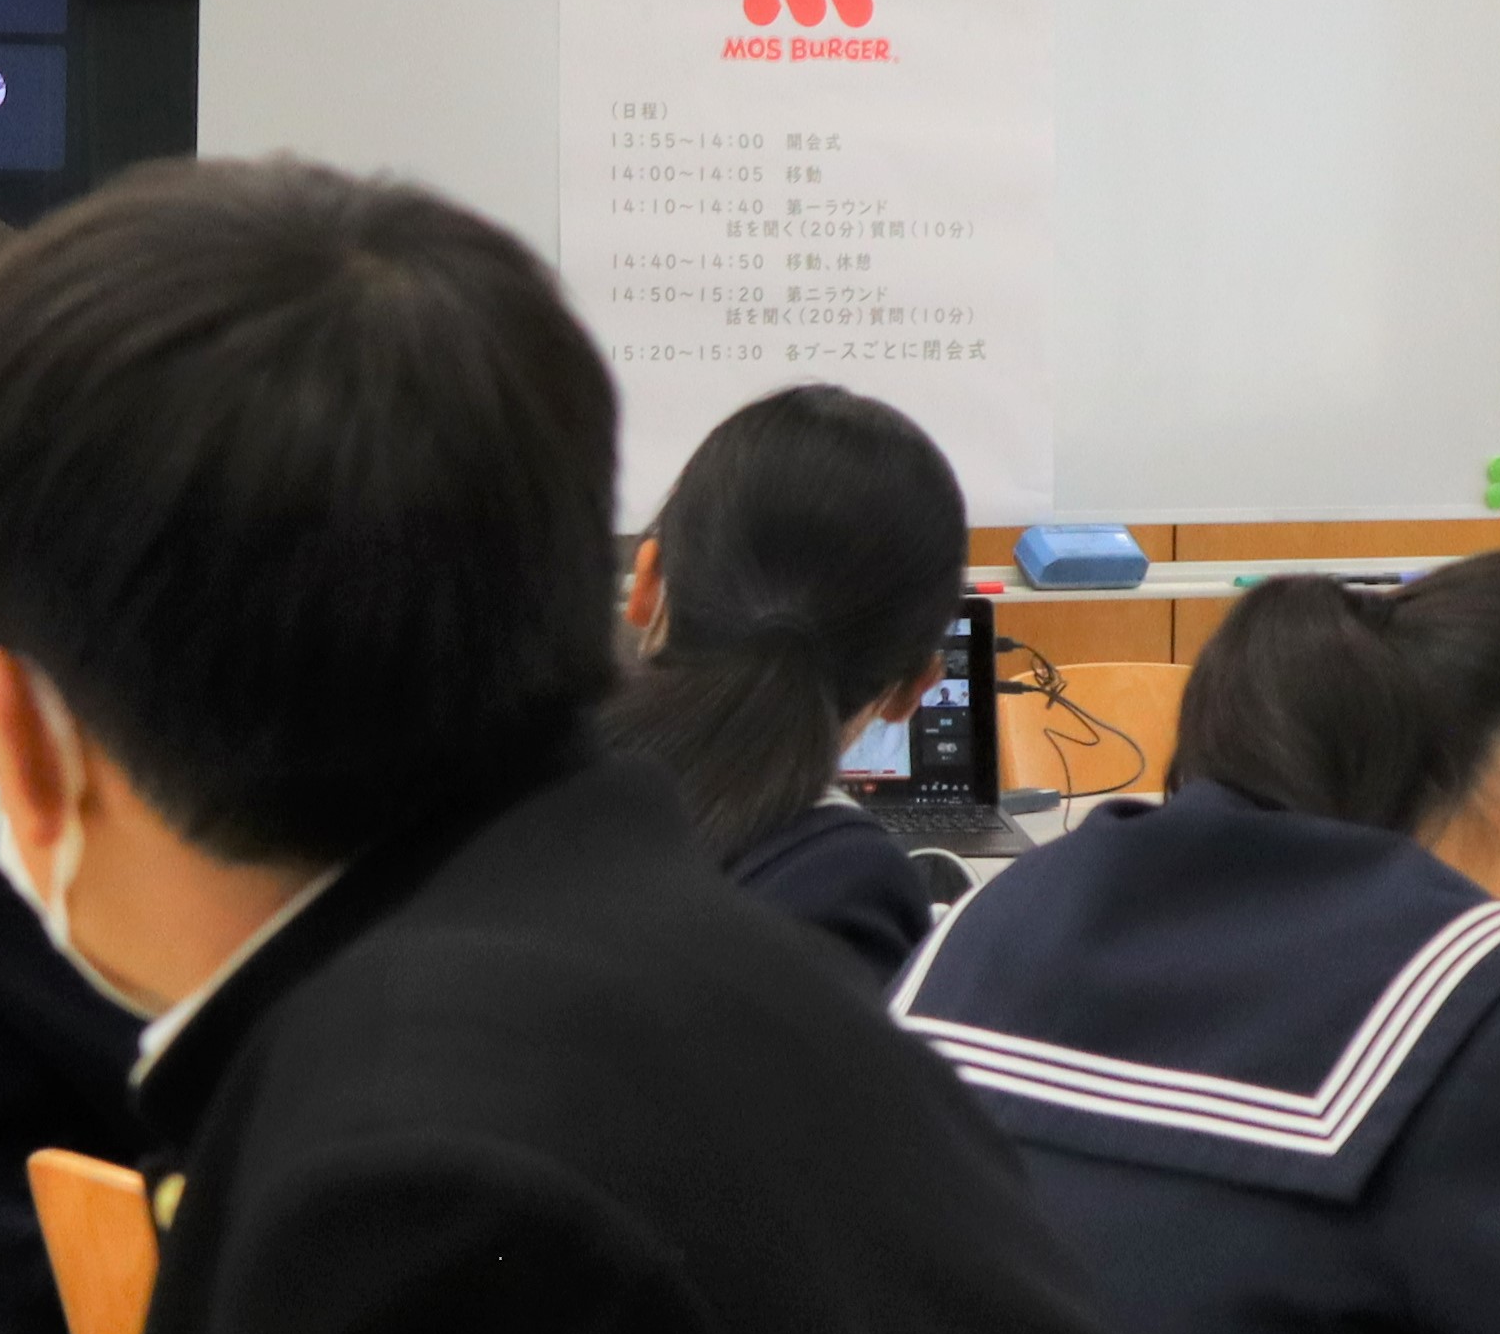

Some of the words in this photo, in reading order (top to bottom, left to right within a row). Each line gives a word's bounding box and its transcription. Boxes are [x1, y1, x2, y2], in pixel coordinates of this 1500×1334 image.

[722, 37, 782, 61] MOS
[786, 133, 842, 152] 開会式
[785, 165, 822, 184] 移動
[786, 198, 888, 216] 第一ラウンド
